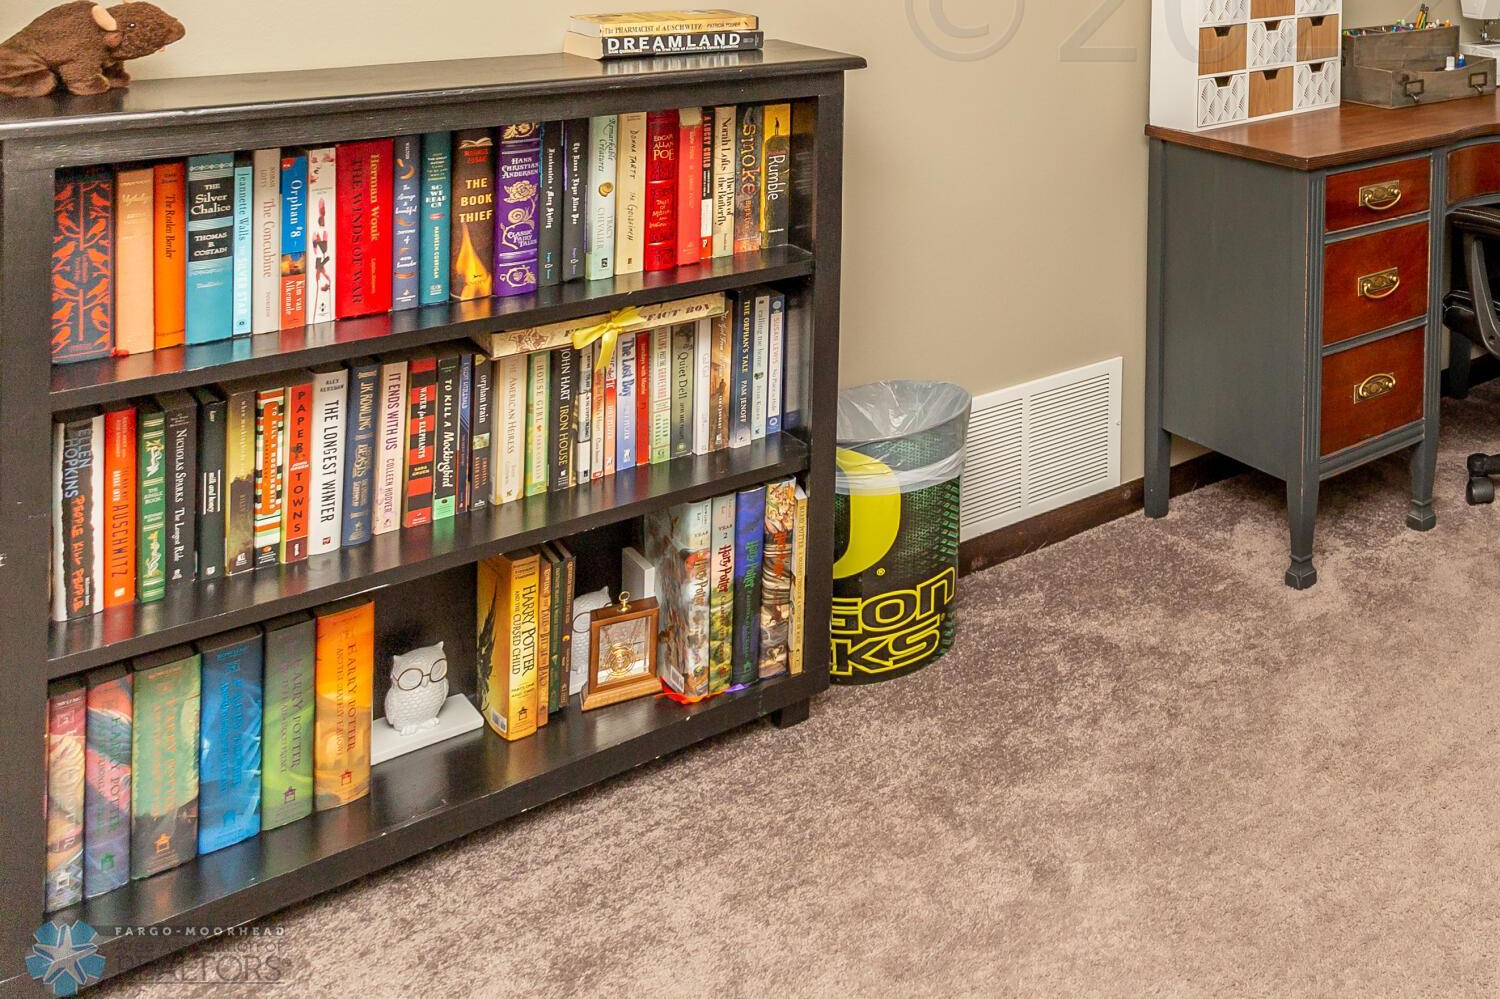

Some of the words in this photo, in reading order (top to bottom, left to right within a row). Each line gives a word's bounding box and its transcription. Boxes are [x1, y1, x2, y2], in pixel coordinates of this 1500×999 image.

[608, 34, 740, 50] DREAMLAND
[630, 130, 640, 153] DONNA
[720, 117, 731, 146] Norah
[502, 162, 539, 173] CHRISTIAN
[630, 155, 638, 180] TARTT
[653, 149, 674, 161] POE
[720, 148, 731, 171] Lofts
[741, 124, 760, 195] smoke
[370, 154, 380, 203] Herman
[466, 178, 487, 189] THE
[502, 170, 538, 179] ANDERSEN
[767, 154, 786, 201] Rumble
[196, 193, 228, 203] Silver
[239, 173, 249, 214] Jeannette
[286, 180, 302, 225] Orphan
[461, 194, 492, 207] BOOK
[191, 204, 231, 215] Chalice
[263, 199, 276, 218] The
[459, 211, 493, 223] THIEF
[716, 191, 726, 226] Butterfly
[239, 217, 249, 241] Walls
[370, 206, 380, 241] Wouk
[195, 233, 227, 241] THOMAS
[263, 221, 276, 278] Concubine
[285, 280, 293, 315] Alkemade
[296, 280, 305, 296] Kim
[622, 338, 635, 357] The
[742, 317, 750, 353] ORPHAN'S
[560, 348, 571, 374] JOHN
[622, 358, 634, 378] Lost
[677, 351, 689, 378] Quiet
[741, 356, 749, 373] TALE
[389, 373, 401, 381] IT
[445, 379, 453, 390] TO
[477, 375, 489, 403] orphan
[536, 364, 545, 396] HOUSE
[560, 376, 570, 401] HART
[619, 381, 634, 397] Boy
[678, 380, 688, 399] Dell
[740, 380, 748, 395] PAM
[387, 385, 401, 409] ENDS
[418, 386, 427, 409] WATER
[444, 395, 452, 418] KILL
[508, 376, 518, 418] AMERICAN
[324, 400, 339, 422] THE
[386, 411, 399, 435] WITH
[478, 403, 487, 424] train
[536, 400, 545, 423] GIRL
[559, 405, 569, 430] IRON
[77, 428, 92, 469] ELLEN
[175, 429, 188, 471] NICHOLAS
[322, 427, 338, 476] LONGEST
[385, 437, 398, 450] US
[417, 422, 426, 458] ELEPHANTS
[558, 433, 569, 466] HOUSE
[64, 439, 79, 498] HOPKINS
[437, 431, 454, 488] Mockingbird
[385, 459, 395, 486] COLLEEN
[175, 473, 187, 503] SPARKS
[383, 487, 393, 513] HOOVER
[320, 480, 336, 523] WINTER
[175, 508, 185, 521] The
[112, 505, 128, 579] AUSCHWITZ
[172, 523, 185, 544] Longest
[717, 544, 732, 567] Harry
[717, 567, 732, 593] Potter
[523, 584, 537, 625] HARRY
[693, 581, 708, 607] Potter
[512, 614, 521, 646] CURSED
[512, 648, 521, 675] CHILD
[521, 629, 536, 677] POTTER
